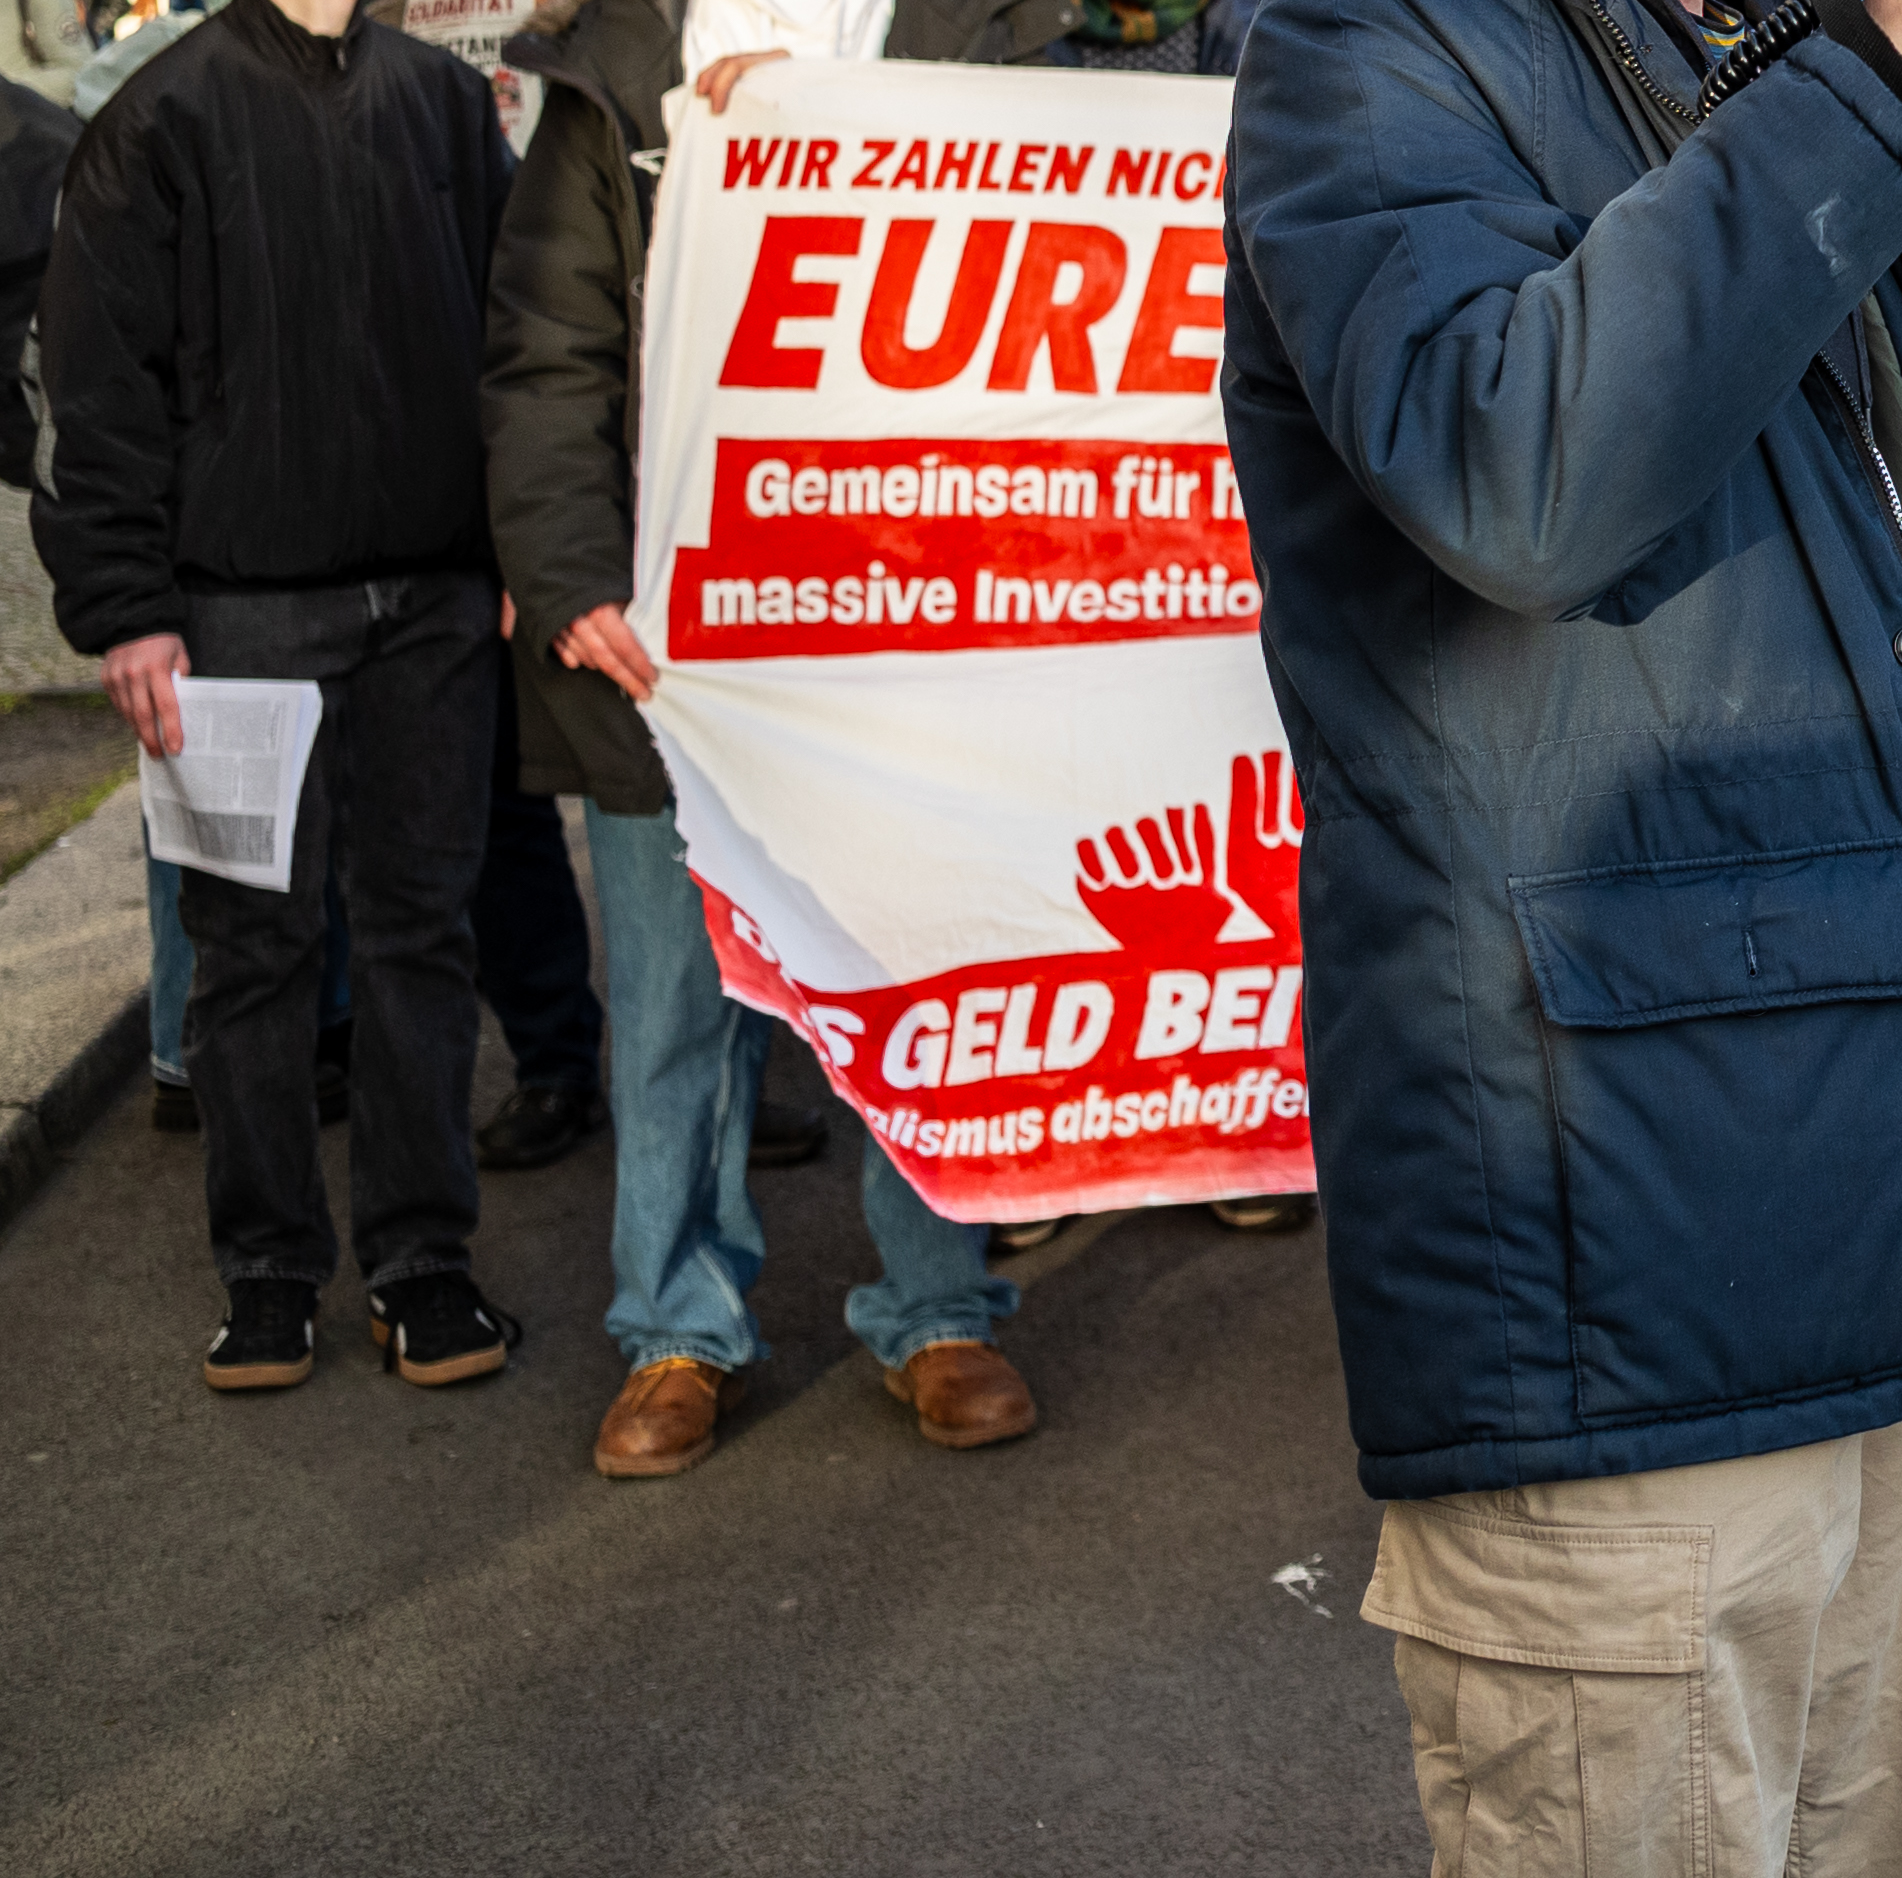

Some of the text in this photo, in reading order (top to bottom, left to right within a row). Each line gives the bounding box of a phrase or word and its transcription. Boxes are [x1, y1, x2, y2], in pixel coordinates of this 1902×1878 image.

[722, 137, 839, 192] WIR
[852, 139, 1096, 196] ZAHLEN
[718, 214, 1228, 394] EURE
[745, 454, 1097, 519] Gemeinsam
[1112, 456, 1197, 518] für
[702, 561, 956, 626] massive
[975, 564, 1262, 623] Investitio
[882, 980, 1115, 1090] GELD
[865, 1101, 1043, 1160] alismus
[1051, 1068, 1309, 1143] abschaffe
